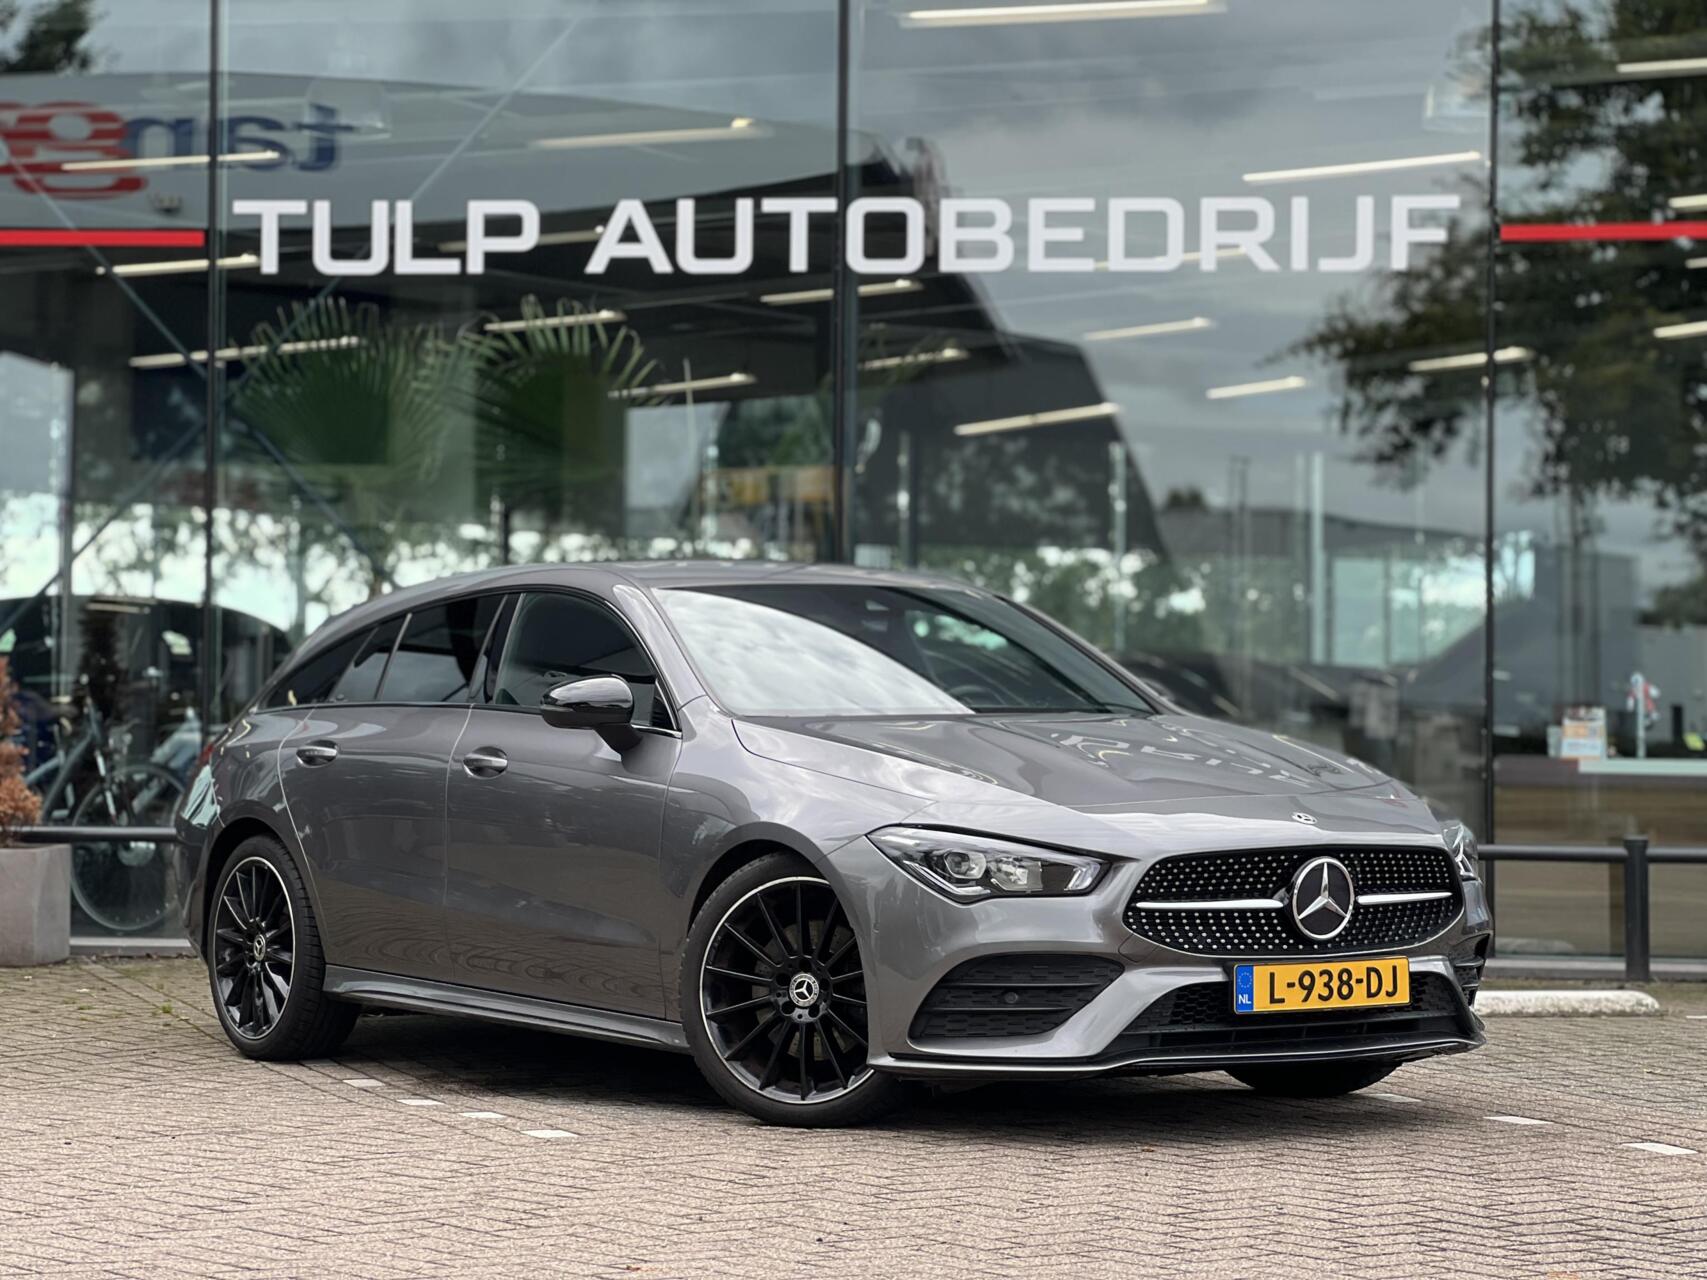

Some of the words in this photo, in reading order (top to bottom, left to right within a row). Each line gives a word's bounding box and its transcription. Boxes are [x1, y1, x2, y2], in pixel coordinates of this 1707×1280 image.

[232, 200, 541, 276] TULP
[584, 194, 1461, 274] AUTOBEDRIJF
[1238, 993, 1252, 1005] NL
[1269, 965, 1398, 1005] L-938-DJ
